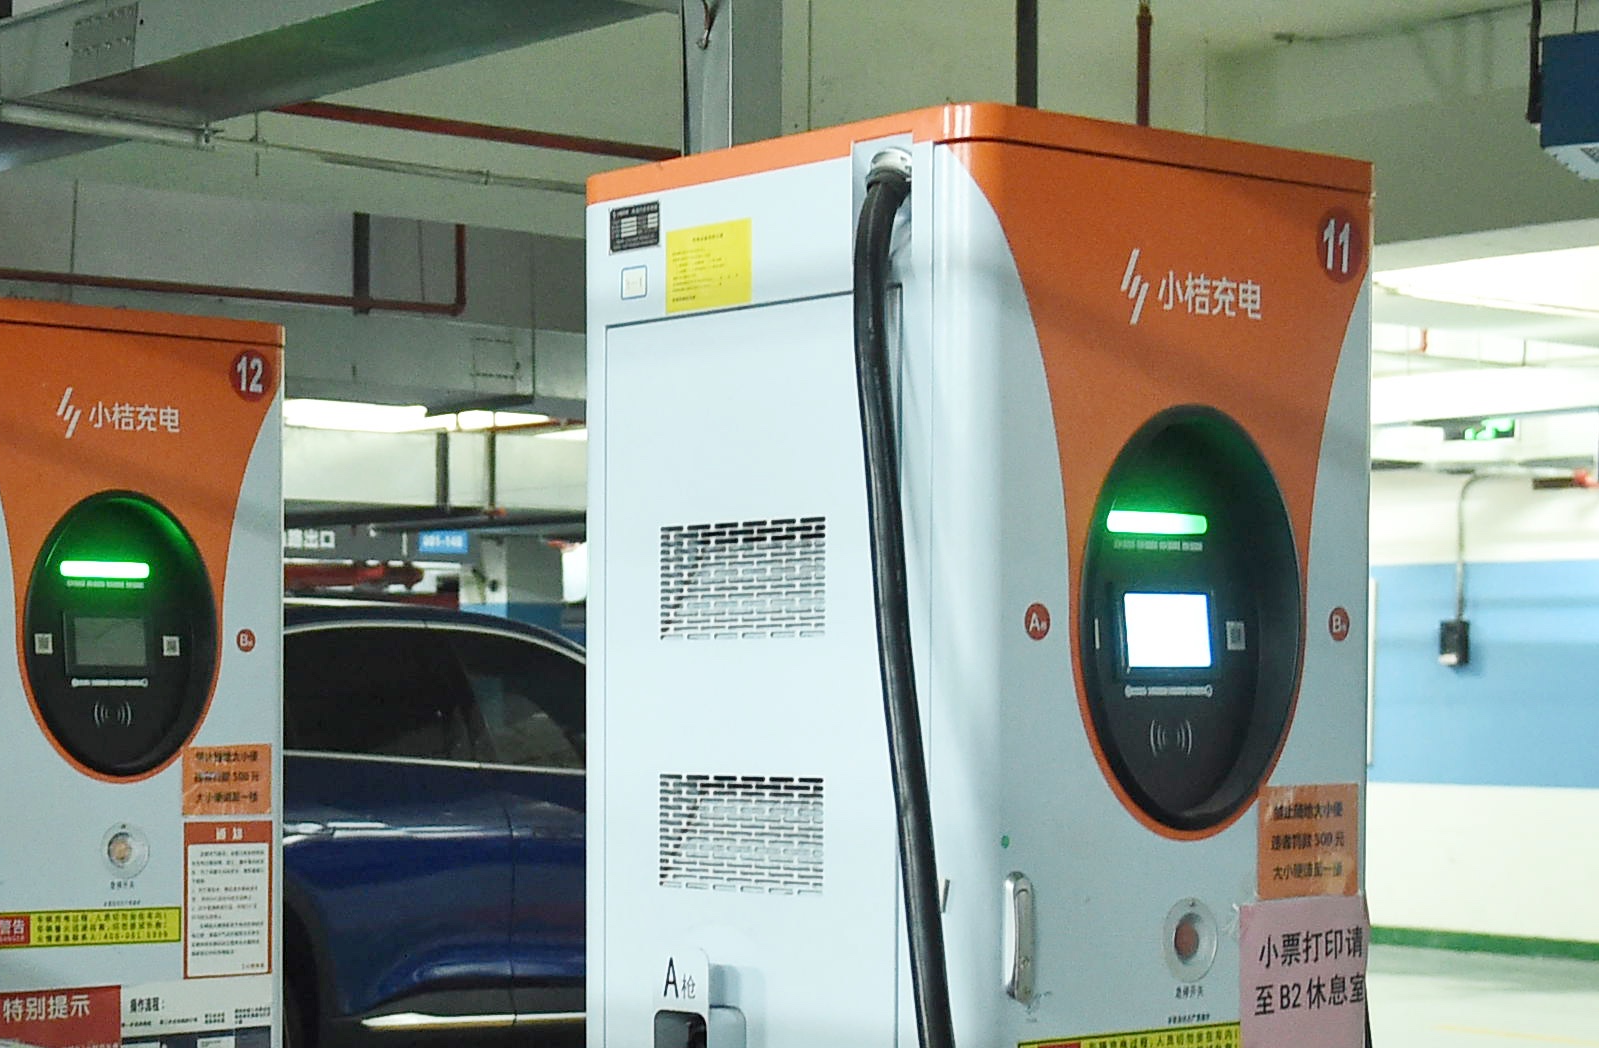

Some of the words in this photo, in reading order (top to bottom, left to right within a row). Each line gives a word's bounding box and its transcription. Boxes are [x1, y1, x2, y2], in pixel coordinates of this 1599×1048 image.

[1322, 218, 1351, 275] 11
[1157, 271, 1263, 321] 小桔充电
[236, 355, 264, 394] 12
[88, 401, 181, 434] 小桔充电
[1258, 925, 1363, 969] 小票打印请
[663, 956, 696, 1000] A枪
[1254, 973, 1366, 1016] 至B2休息室
[2, 993, 91, 1023] 特别提示
